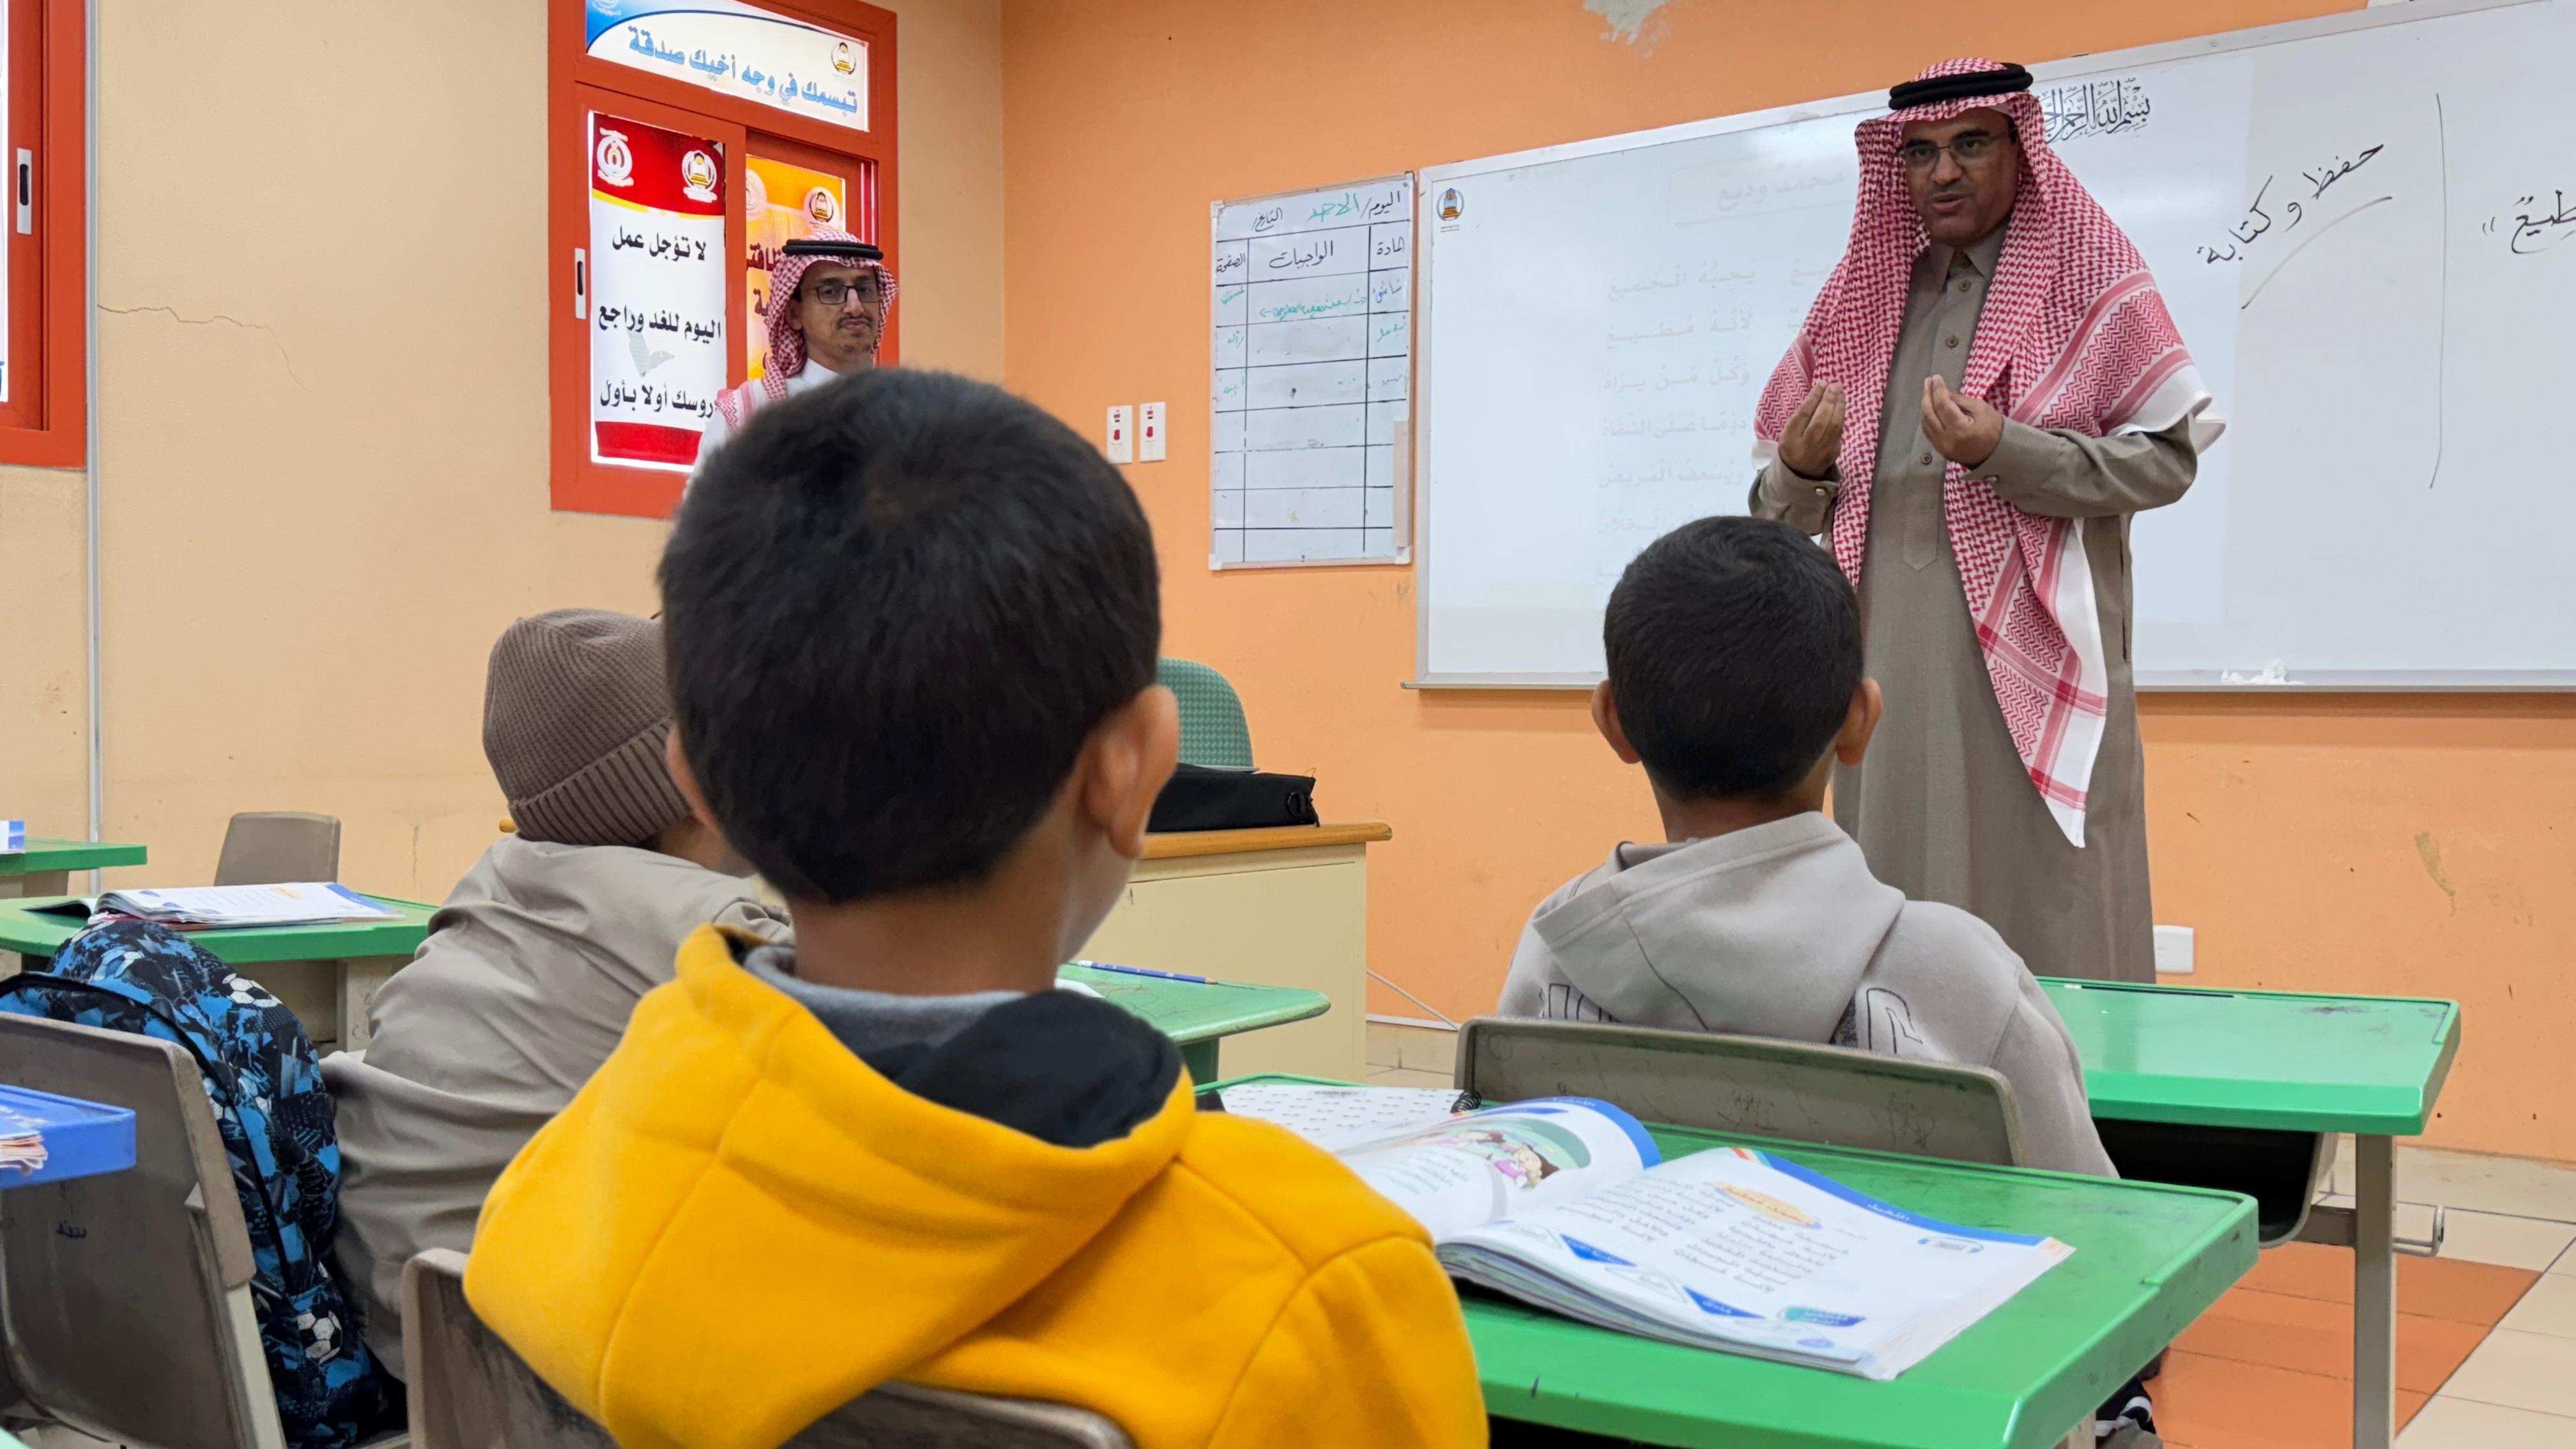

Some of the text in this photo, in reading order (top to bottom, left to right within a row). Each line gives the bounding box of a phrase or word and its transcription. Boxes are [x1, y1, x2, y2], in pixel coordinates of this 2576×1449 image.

[627, 25, 858, 117] تبسمك في وجه أخيك صدقة
[613, 224, 707, 262] لا تؤجل عمل
[599, 305, 721, 344] اليوم للغد وراجع
[672, 389, 716, 418] روسك
